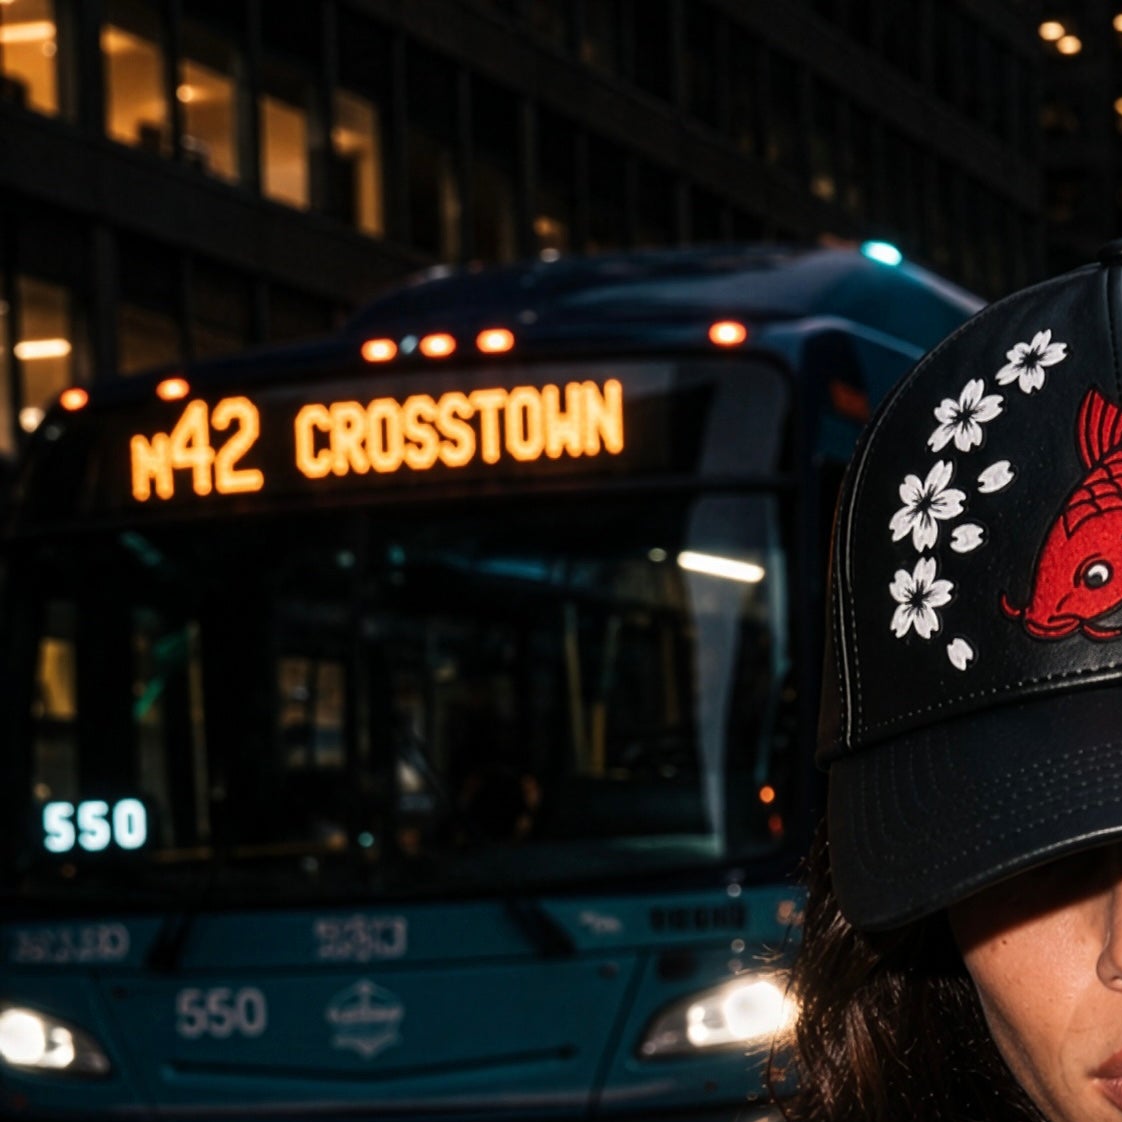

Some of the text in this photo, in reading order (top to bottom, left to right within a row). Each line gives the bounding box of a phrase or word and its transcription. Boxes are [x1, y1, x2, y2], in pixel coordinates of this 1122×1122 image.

[294, 379, 626, 479] CROSSTOWN
[43, 798, 146, 853] 550
[176, 987, 267, 1039] 550
